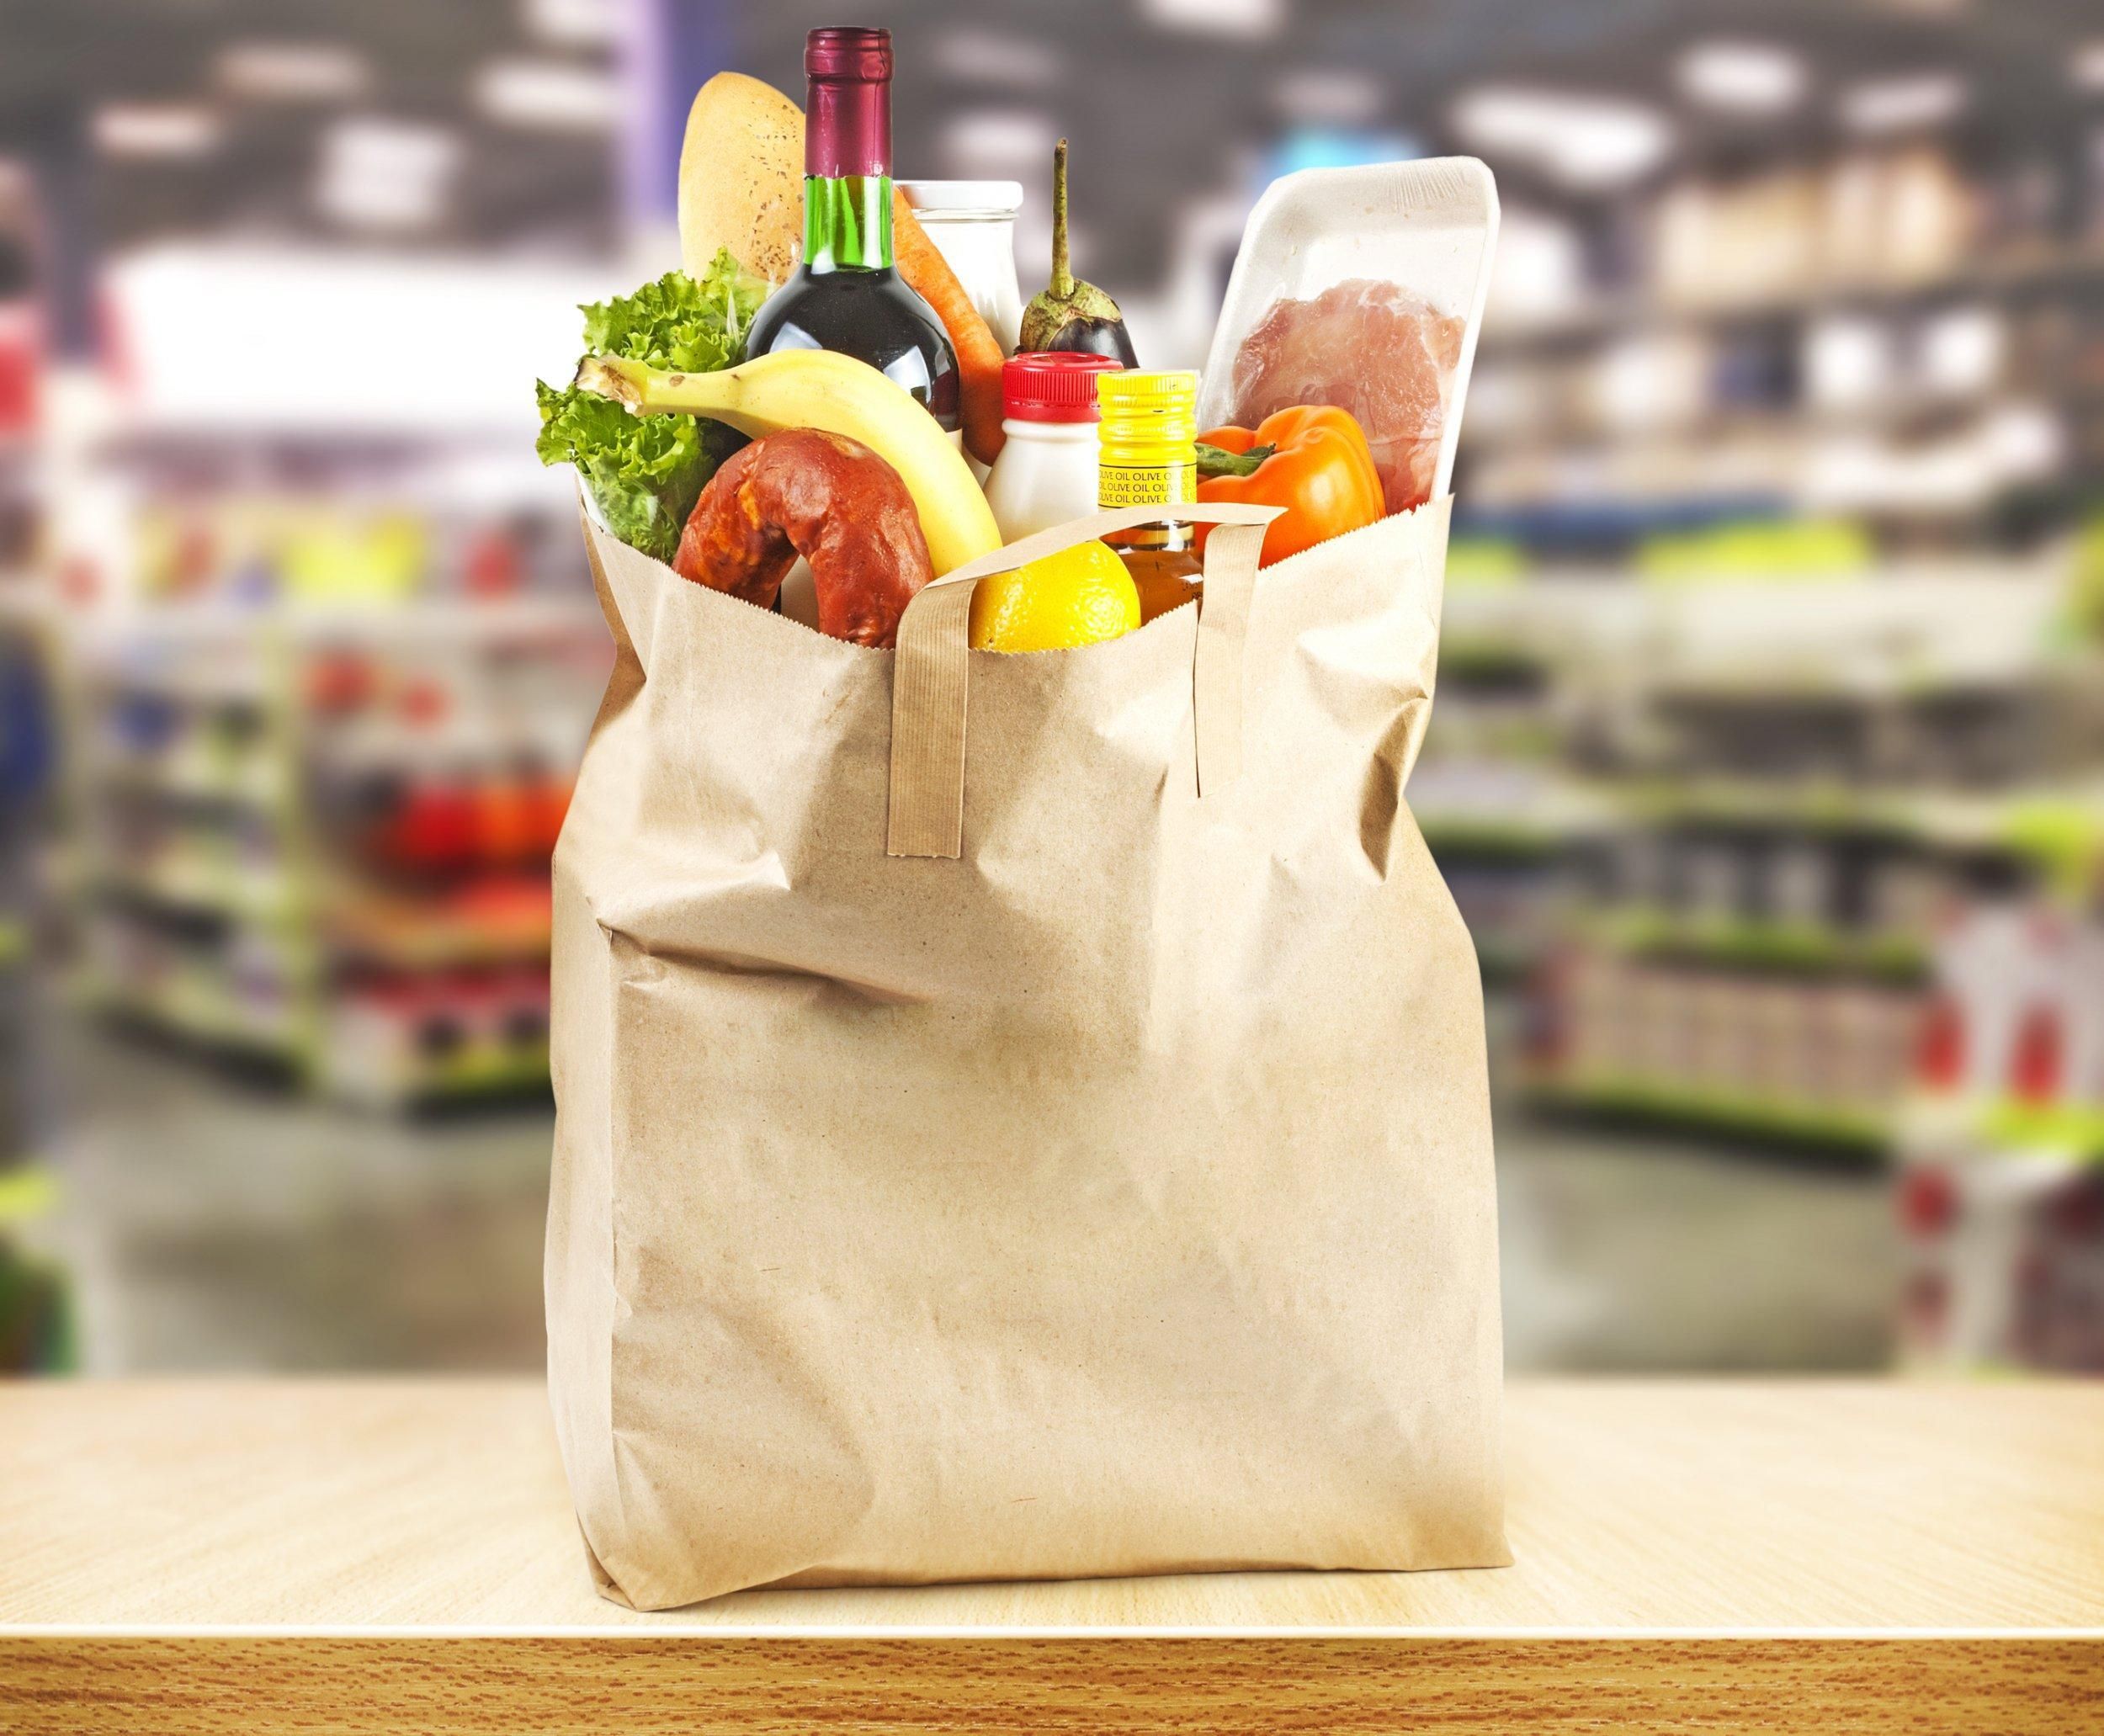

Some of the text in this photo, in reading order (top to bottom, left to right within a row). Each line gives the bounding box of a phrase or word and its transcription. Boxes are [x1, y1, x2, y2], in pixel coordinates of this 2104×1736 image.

[1116, 472, 1130, 480] OIL
[1108, 483, 1130, 491] OLIVE
[1116, 494, 1130, 502] OIL
[1133, 495, 1161, 503] OLIVE
